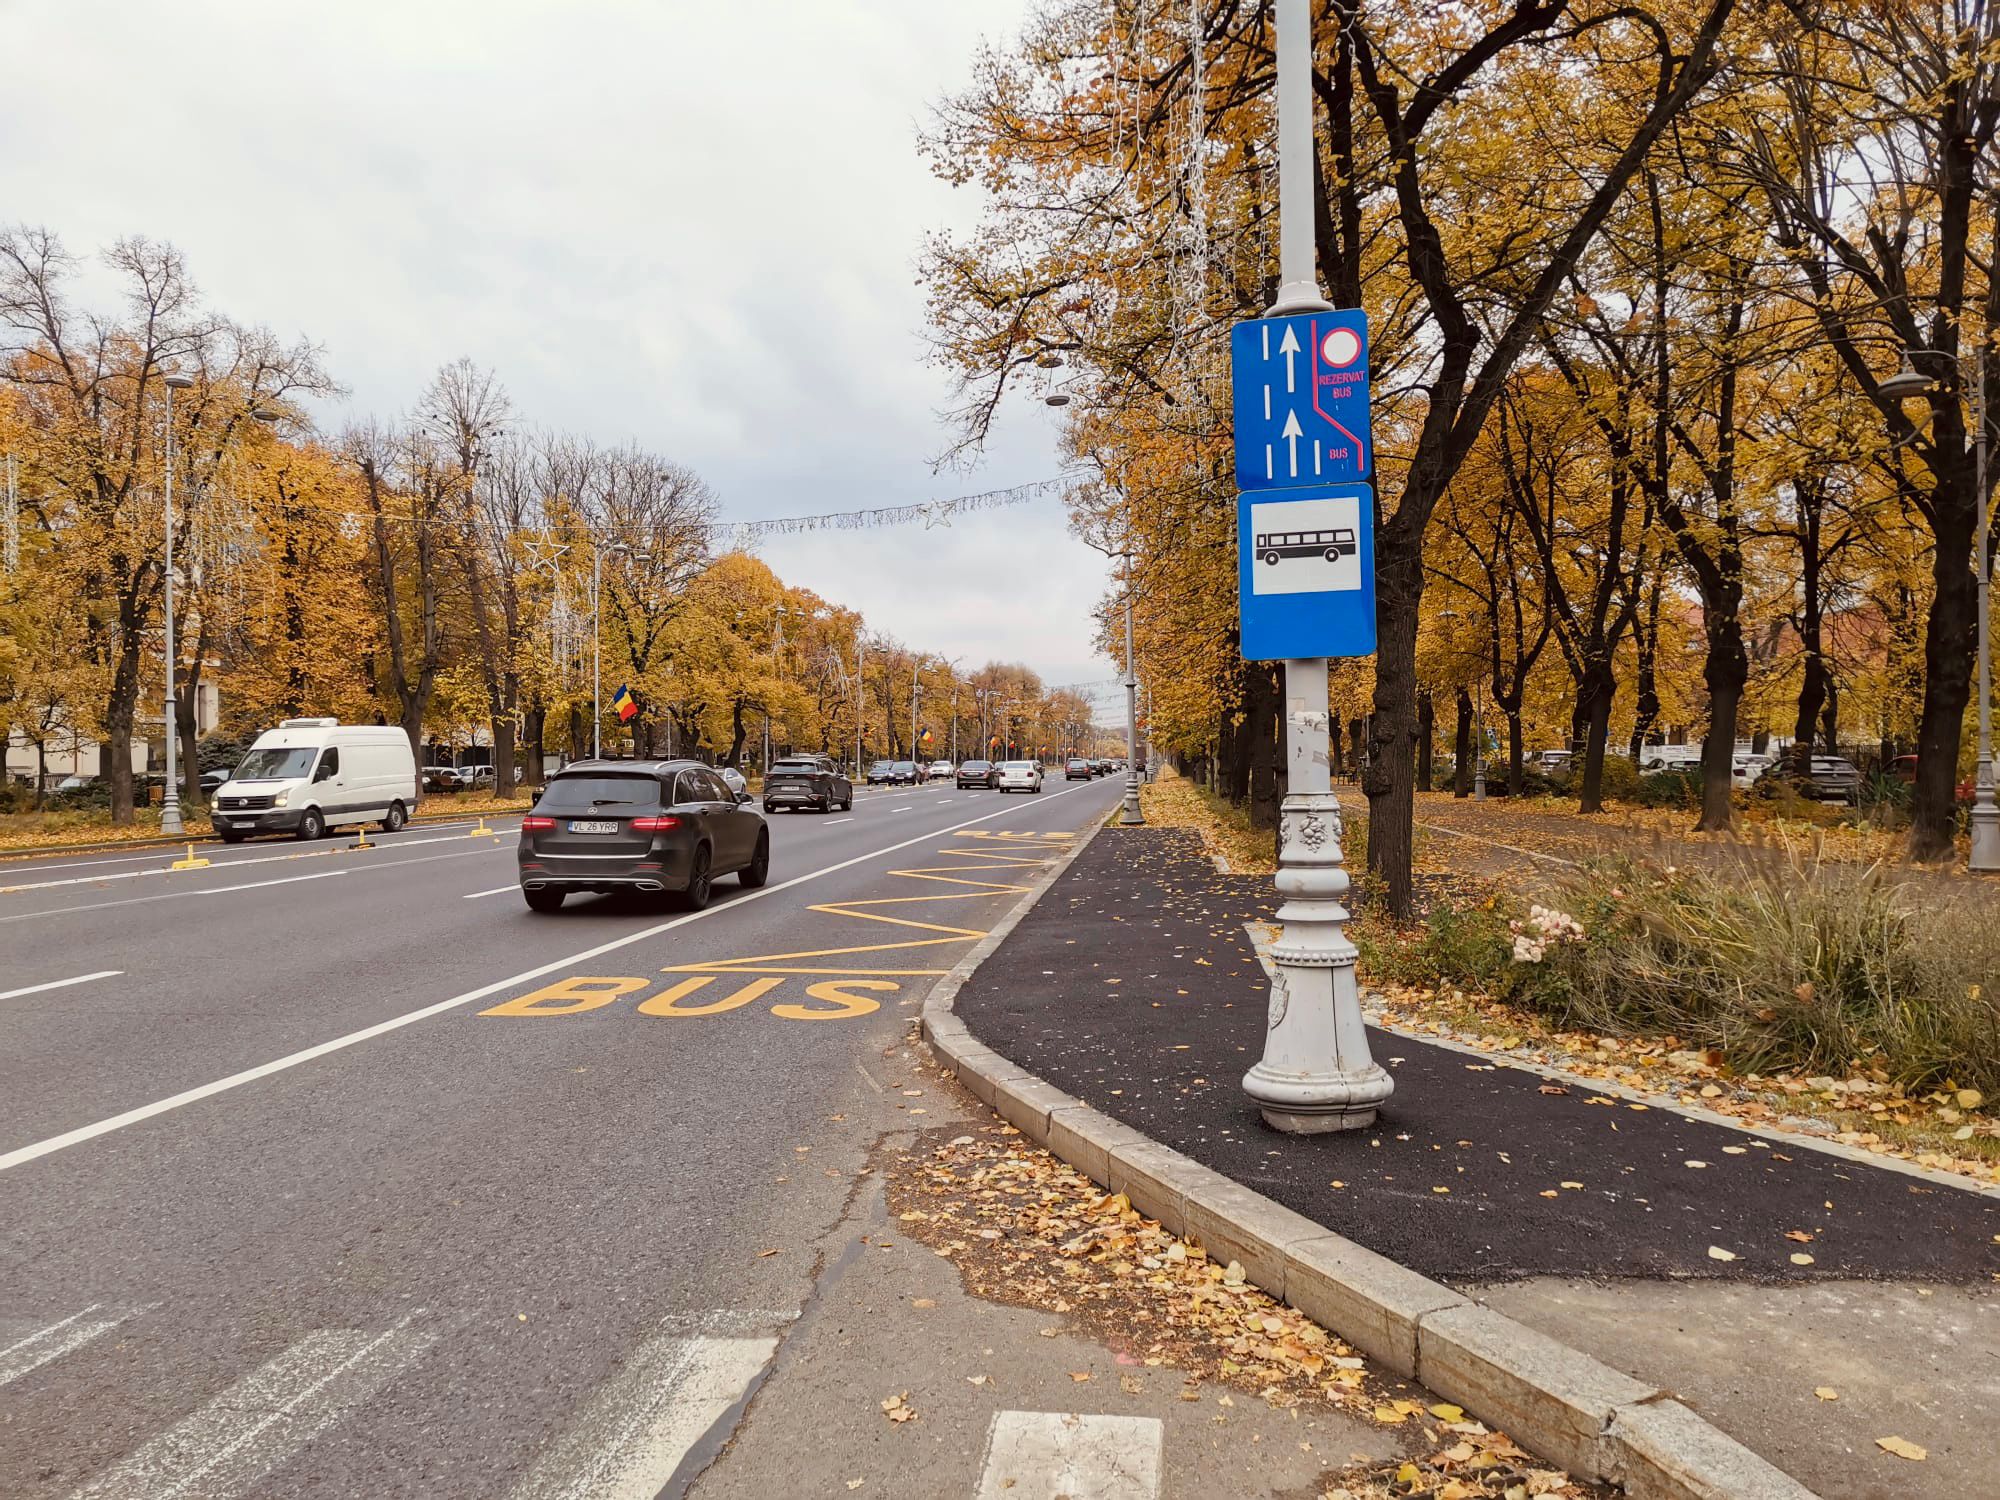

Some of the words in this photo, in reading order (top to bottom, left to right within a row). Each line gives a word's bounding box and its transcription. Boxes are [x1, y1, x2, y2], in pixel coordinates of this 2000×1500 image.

[1319, 371, 1365, 385] REZERVAT
[1333, 386, 1352, 399] BUS
[1329, 447, 1348, 460] BUS
[573, 822, 584, 831] VL
[600, 822, 617, 831] YRR
[476, 976, 901, 1020] BUS
